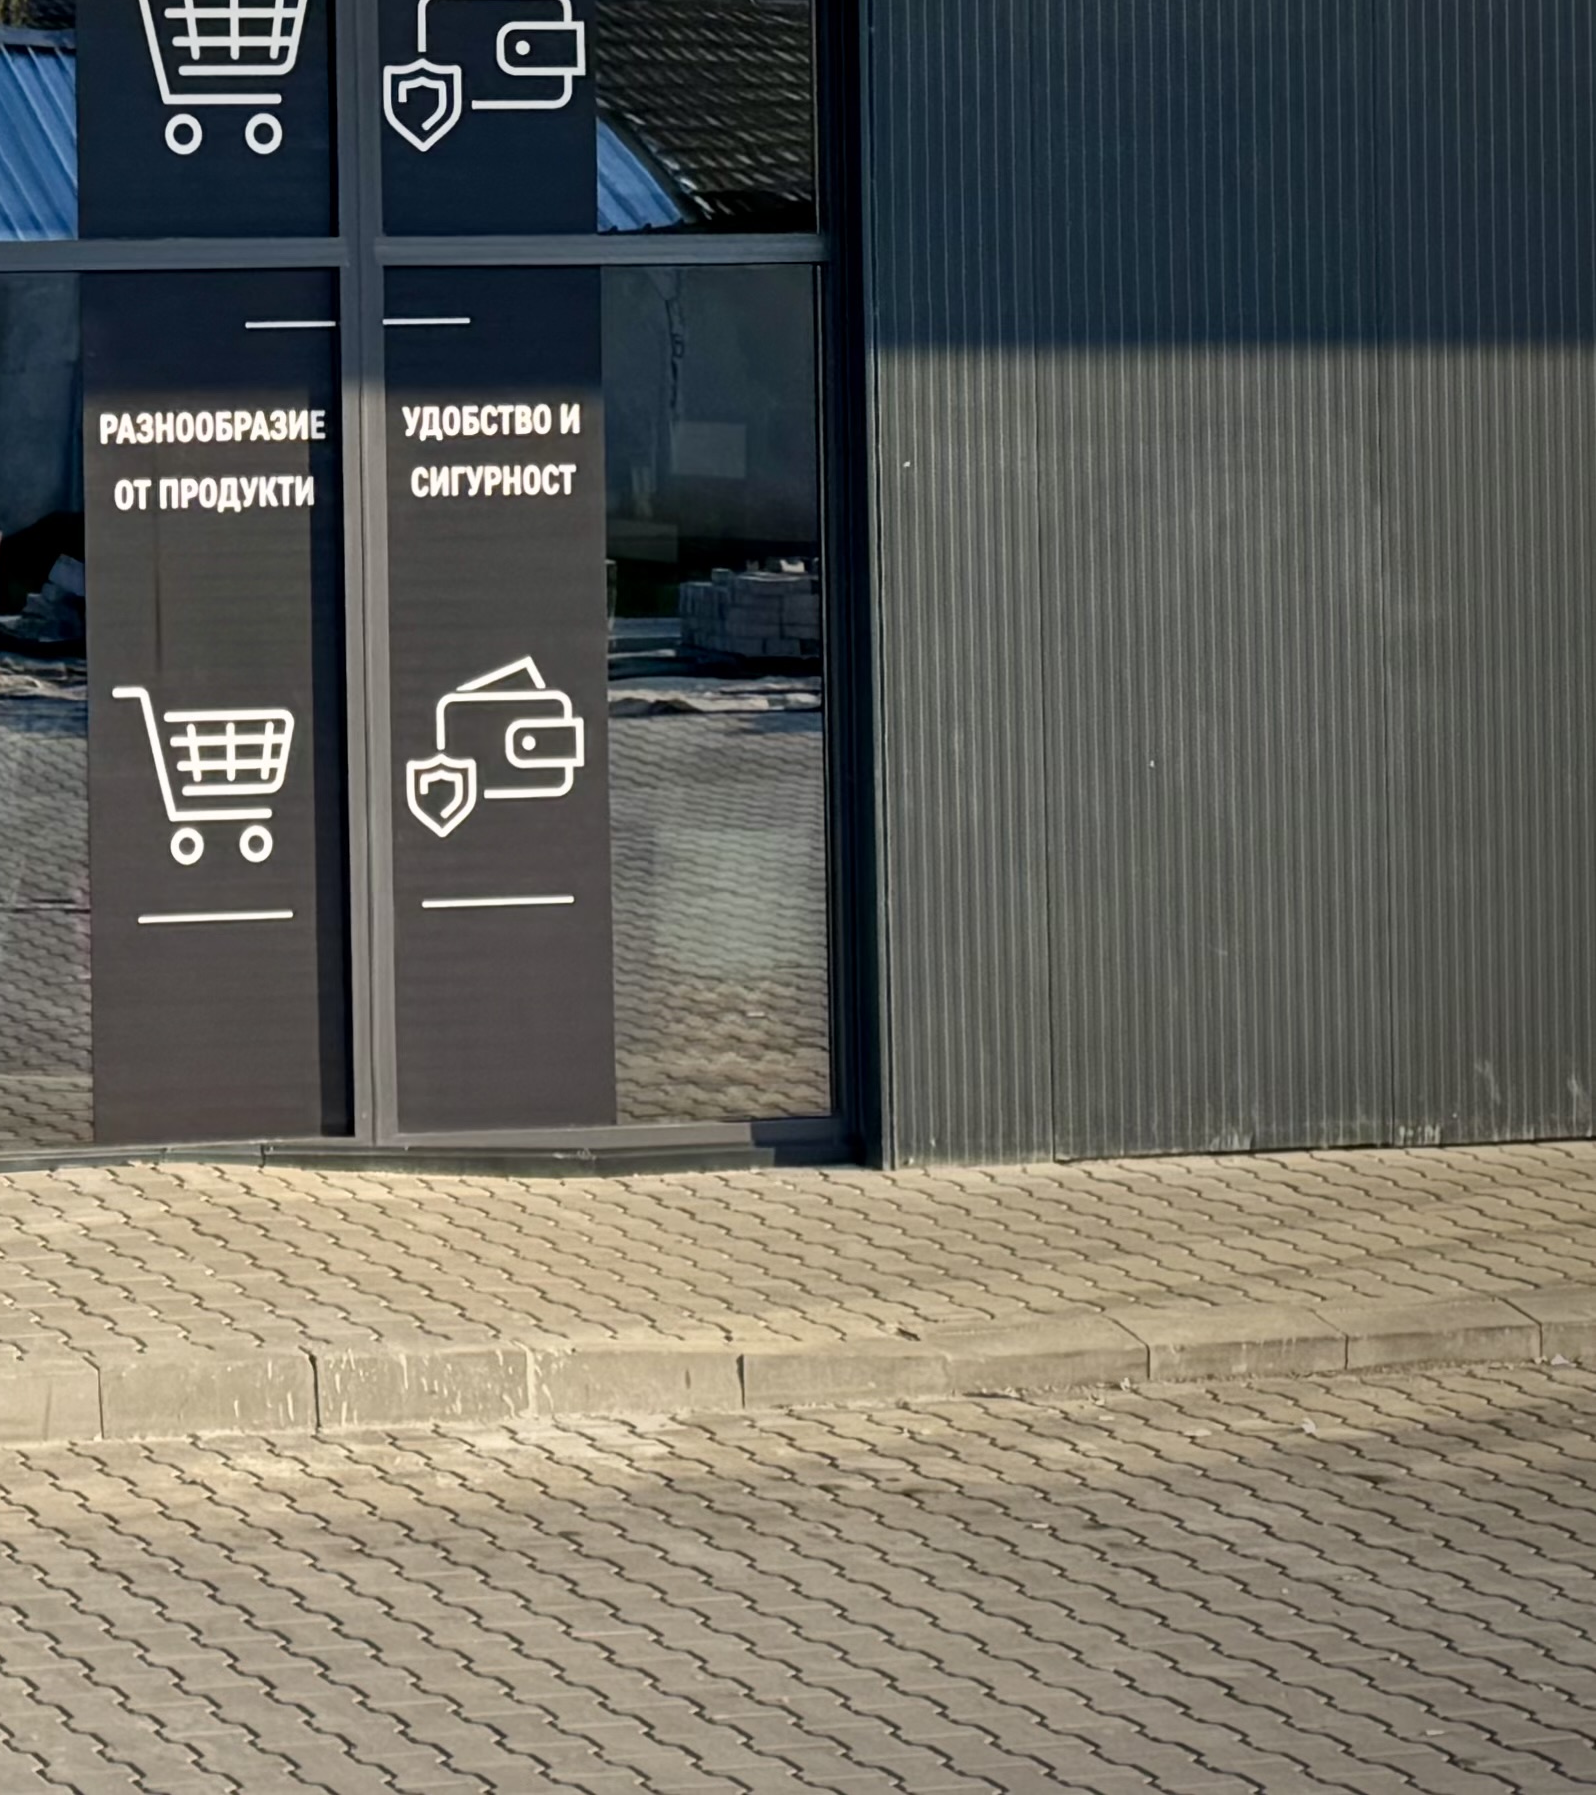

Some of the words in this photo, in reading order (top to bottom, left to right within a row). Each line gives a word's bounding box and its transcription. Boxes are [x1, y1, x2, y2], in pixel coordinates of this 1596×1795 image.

[100, 410, 325, 444] РАЗНООБРАЗИЕ
[402, 404, 552, 441] УДОБСТВО
[560, 404, 580, 434] И
[115, 479, 151, 510] ОТ
[160, 476, 314, 513] ПРОДУКТИ
[411, 464, 576, 497] СИГУРНОСТ
